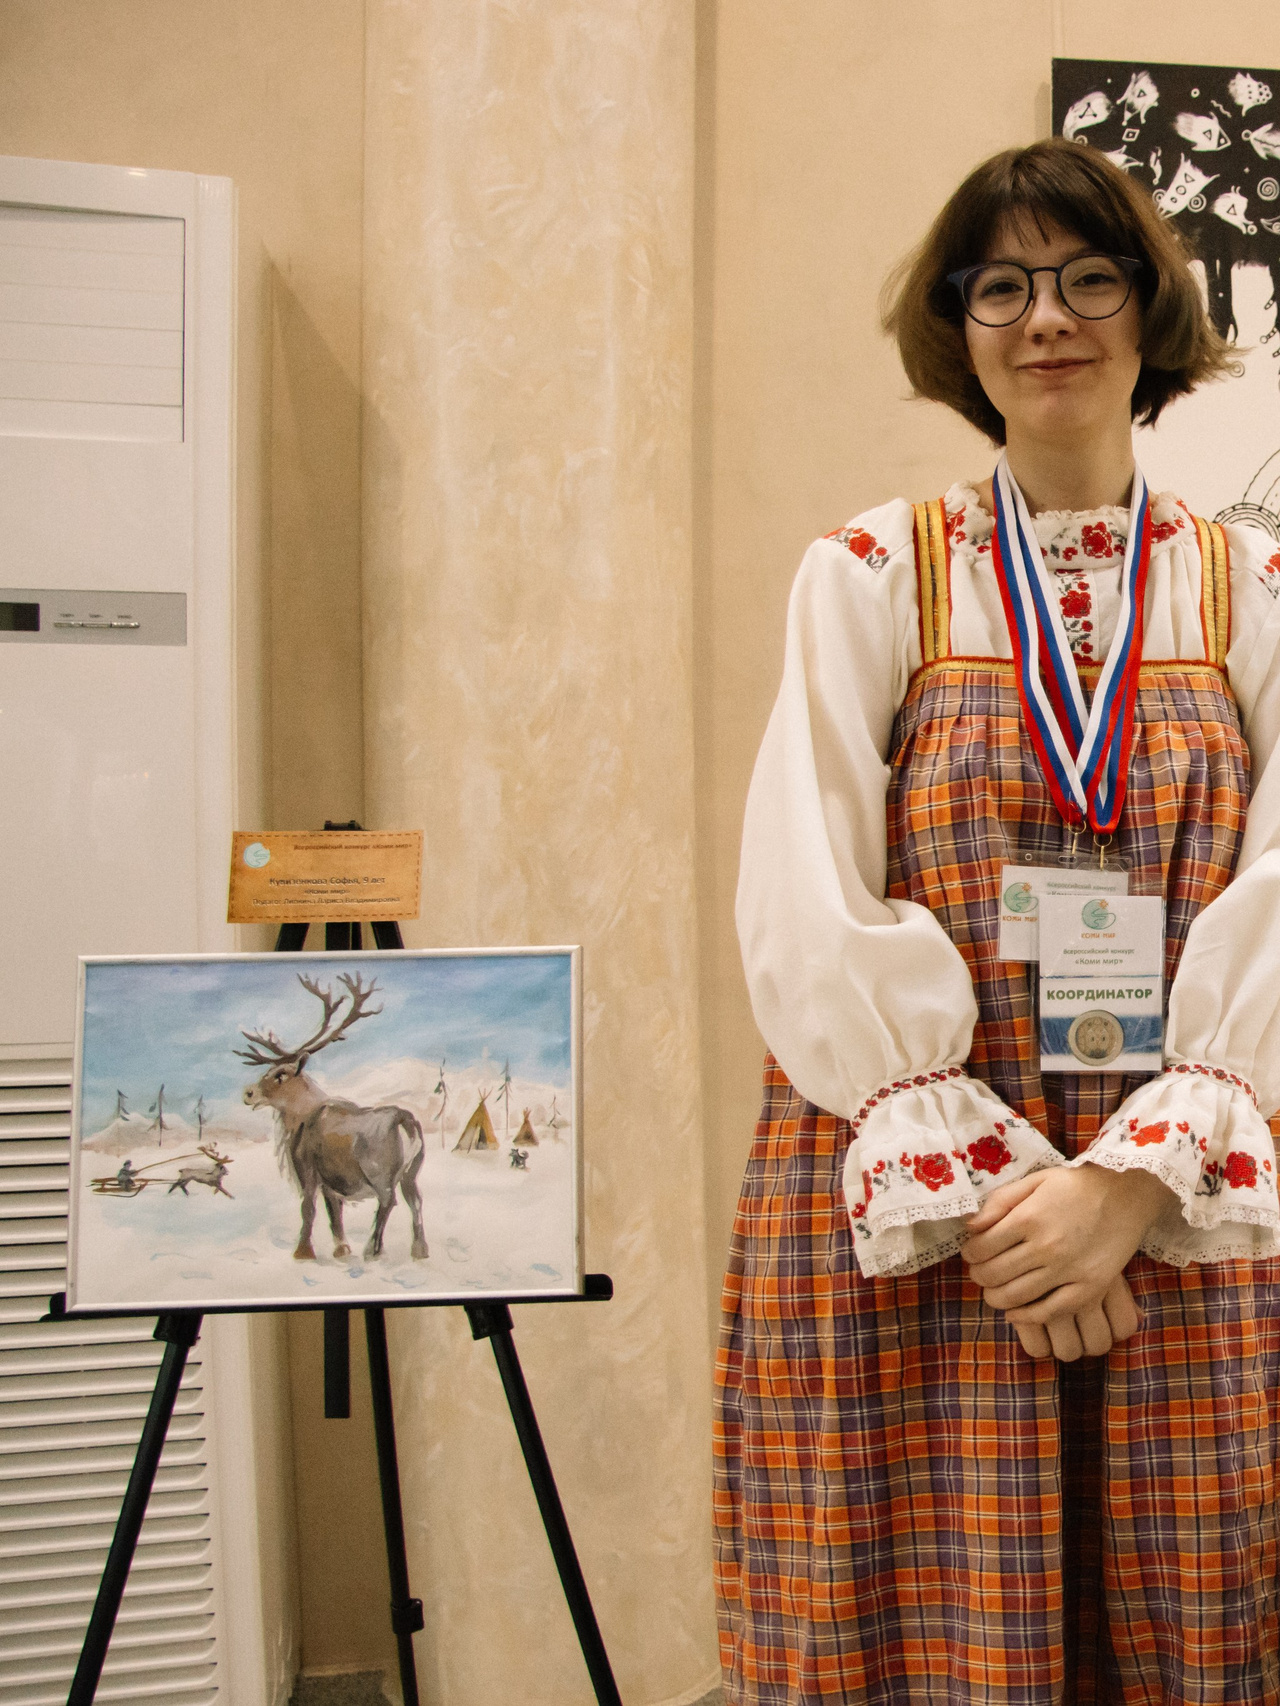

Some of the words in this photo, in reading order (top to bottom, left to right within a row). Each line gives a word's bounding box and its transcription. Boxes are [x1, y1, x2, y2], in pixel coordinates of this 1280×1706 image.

[363, 876, 369, 884] 9
[1063, 948, 1109, 956] Всероссийский
[1110, 948, 1135, 956] конкурс
[1046, 988, 1153, 1001] КООРДИНАТОР
